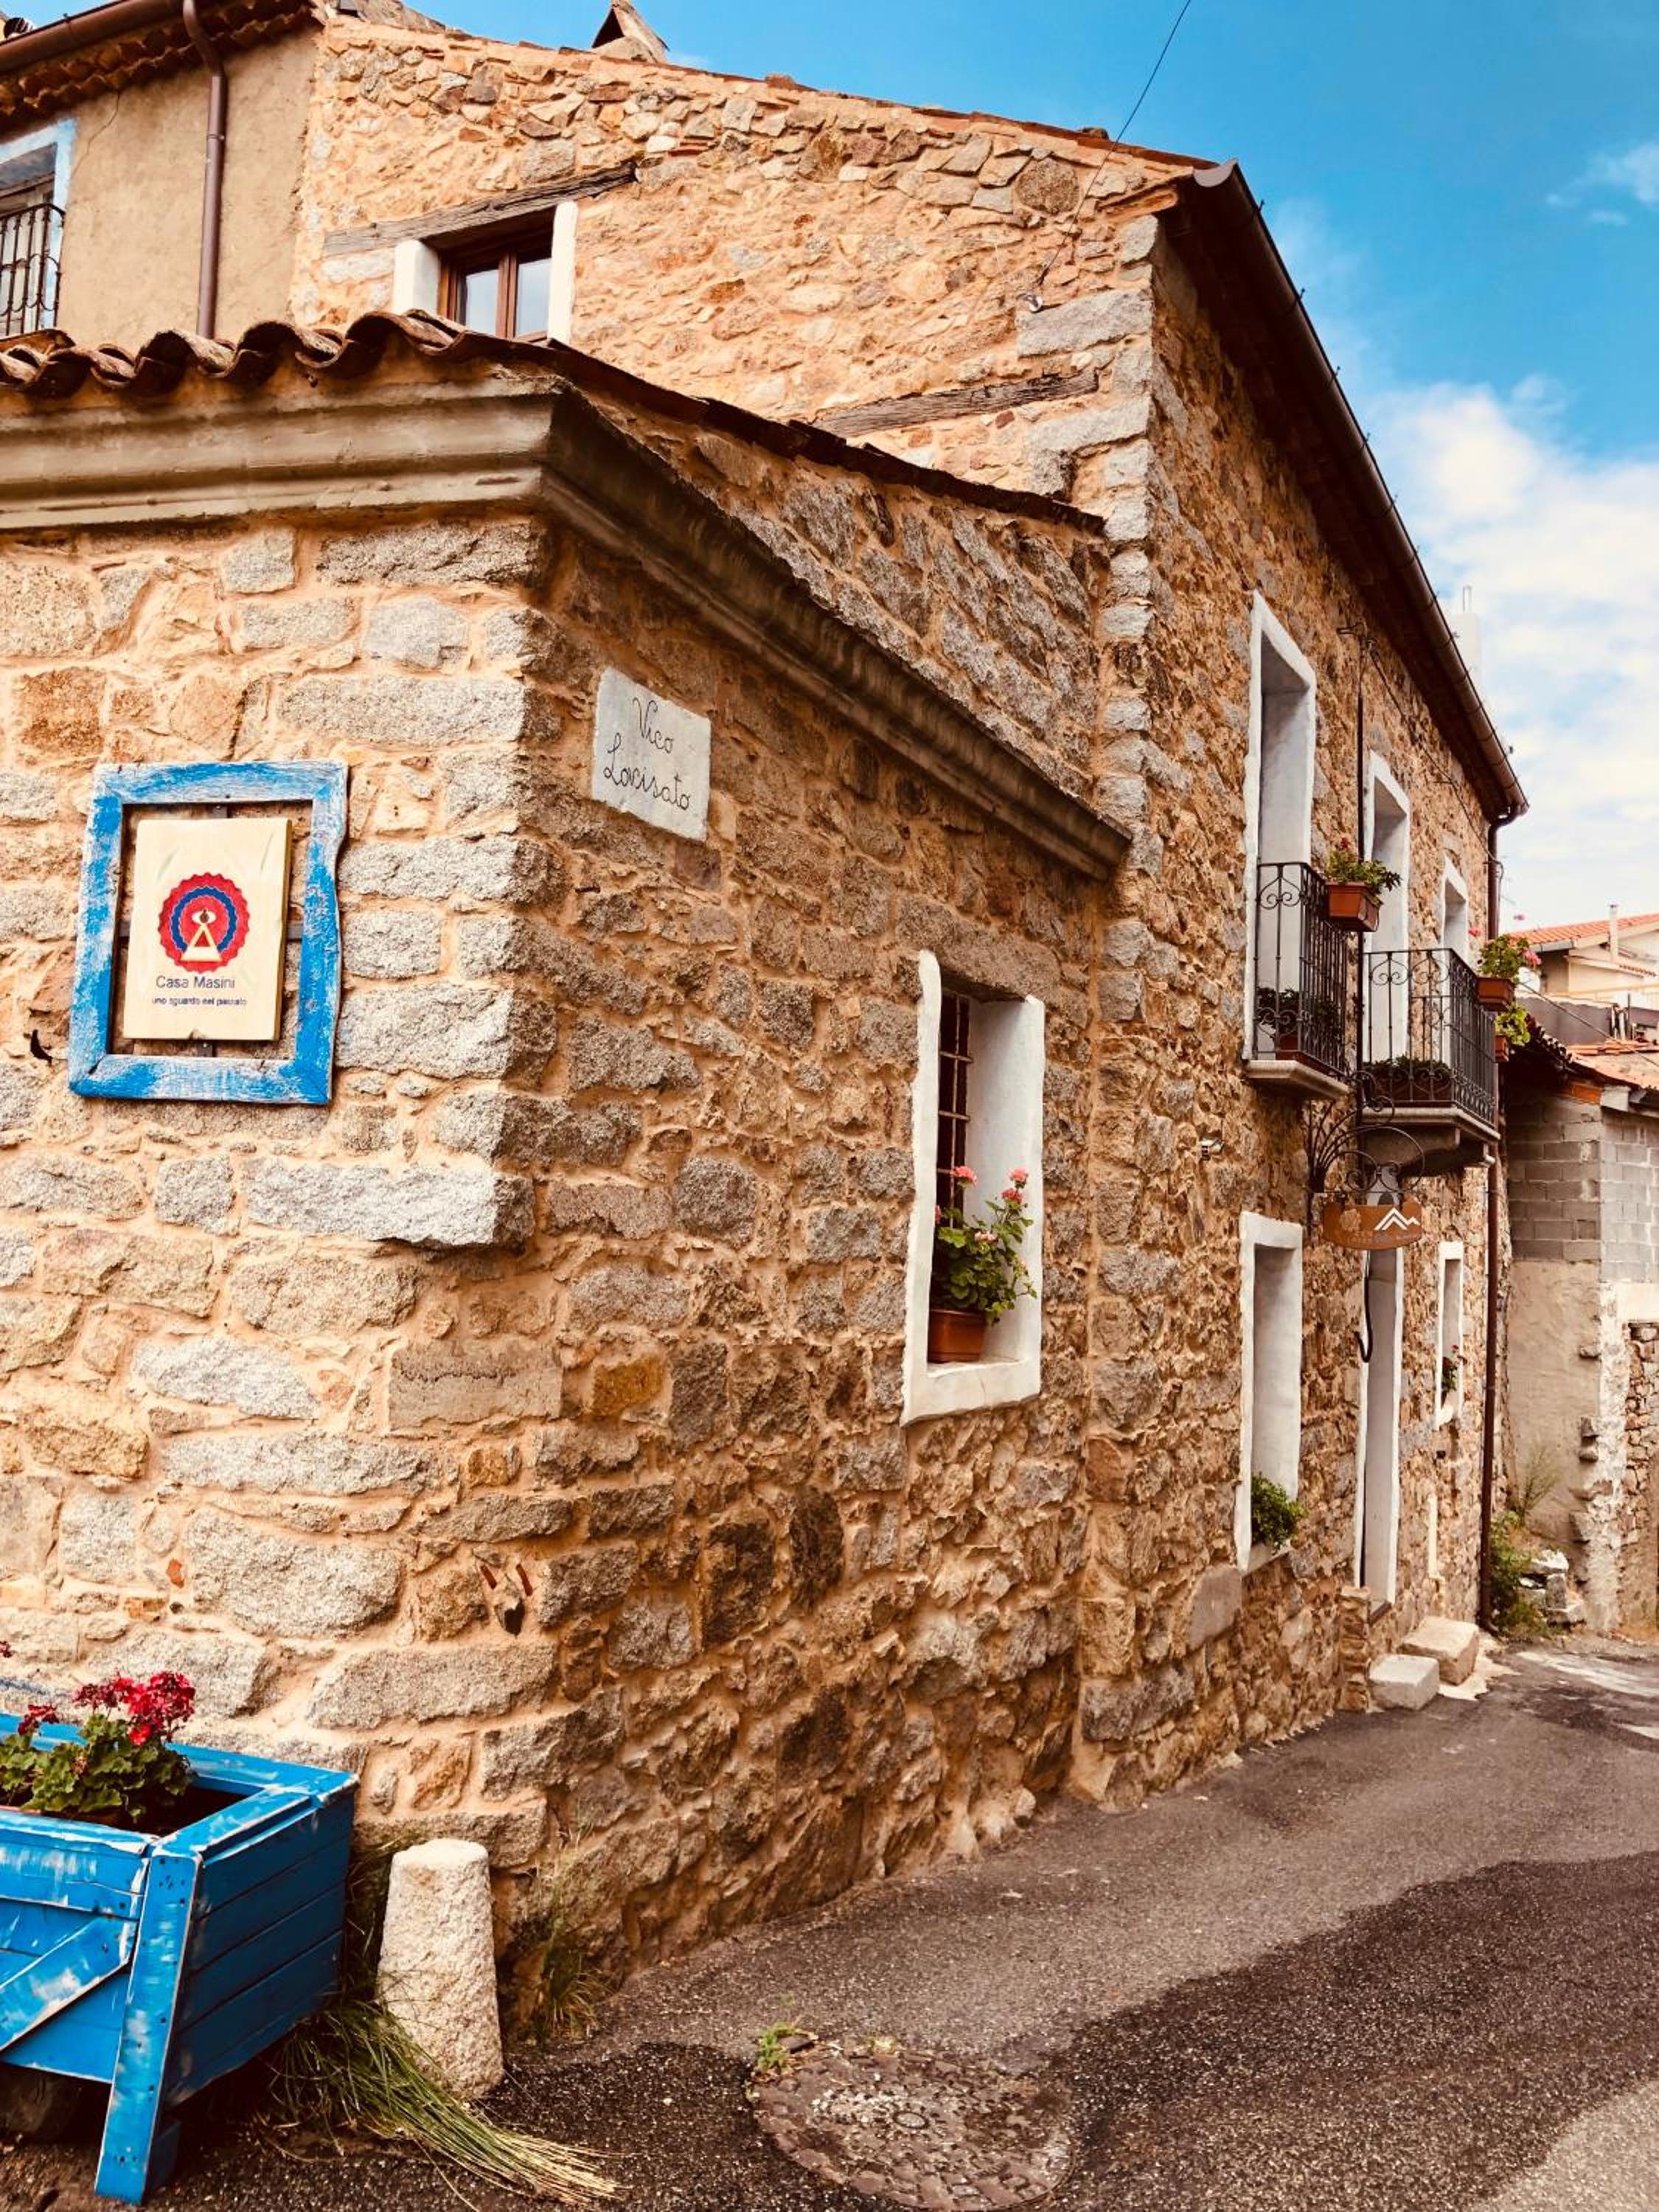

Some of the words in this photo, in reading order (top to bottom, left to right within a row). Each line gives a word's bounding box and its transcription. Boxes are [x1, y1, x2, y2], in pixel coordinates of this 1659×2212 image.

[632, 697, 675, 754] Vico
[156, 975, 189, 989] Casa
[193, 975, 236, 989] Masini
